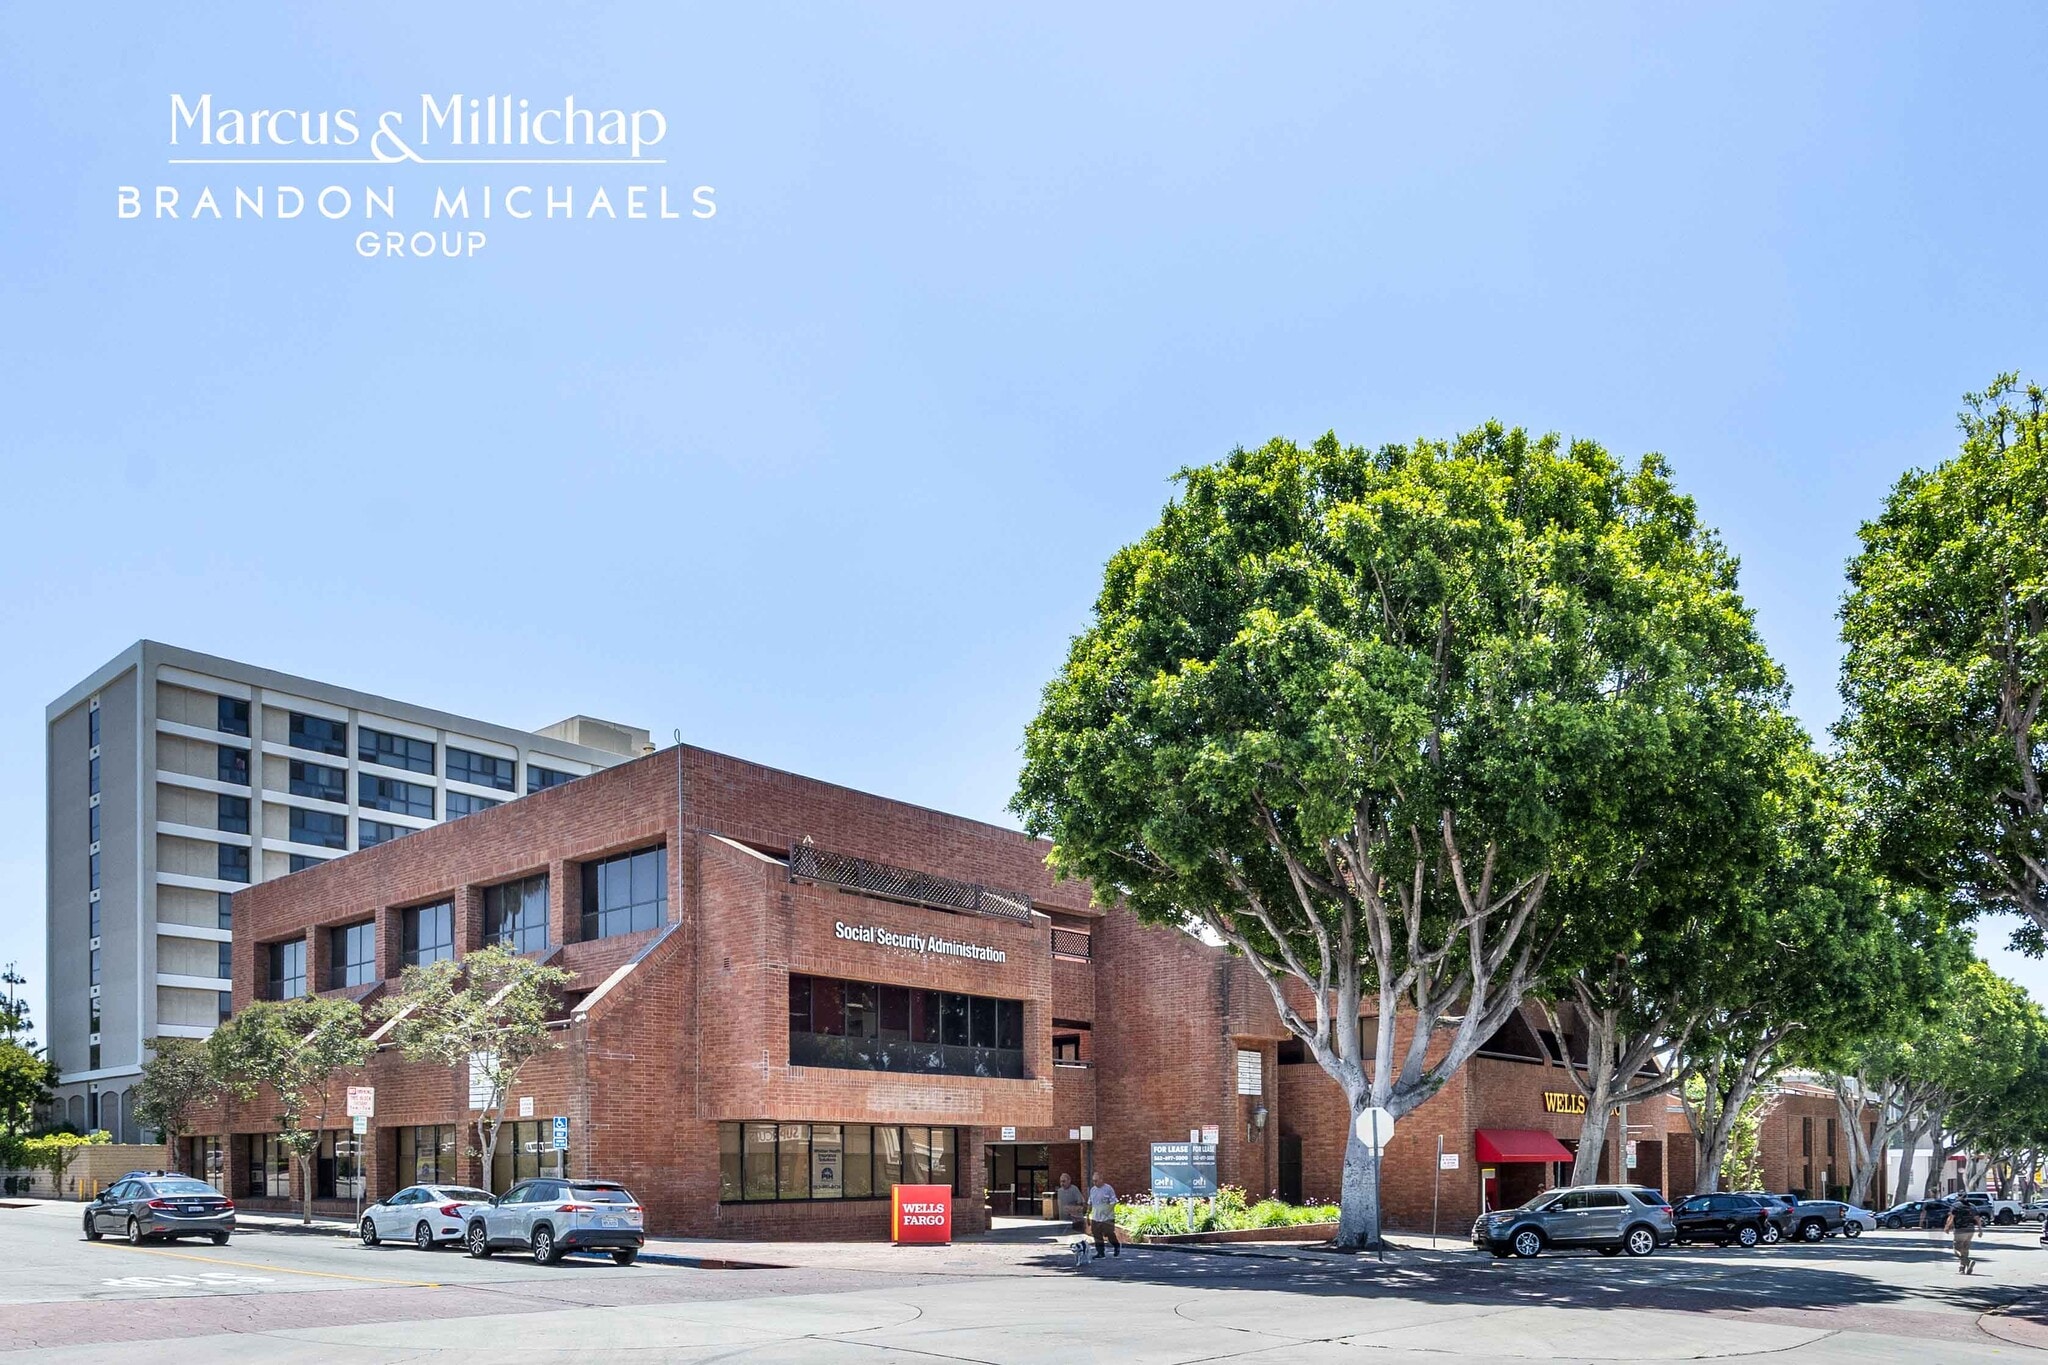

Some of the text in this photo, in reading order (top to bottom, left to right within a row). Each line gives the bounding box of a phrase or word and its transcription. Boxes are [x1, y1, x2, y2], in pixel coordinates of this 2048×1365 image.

[835, 921, 1006, 963] Social Security Administration
[1544, 1092, 1585, 1114] WELLS
[1153, 1145, 1189, 1153] FOR LEASE
[1192, 1145, 1215, 1153] FOR LEASE
[902, 1203, 945, 1214] WELLS
[903, 1215, 945, 1226] FARGO
